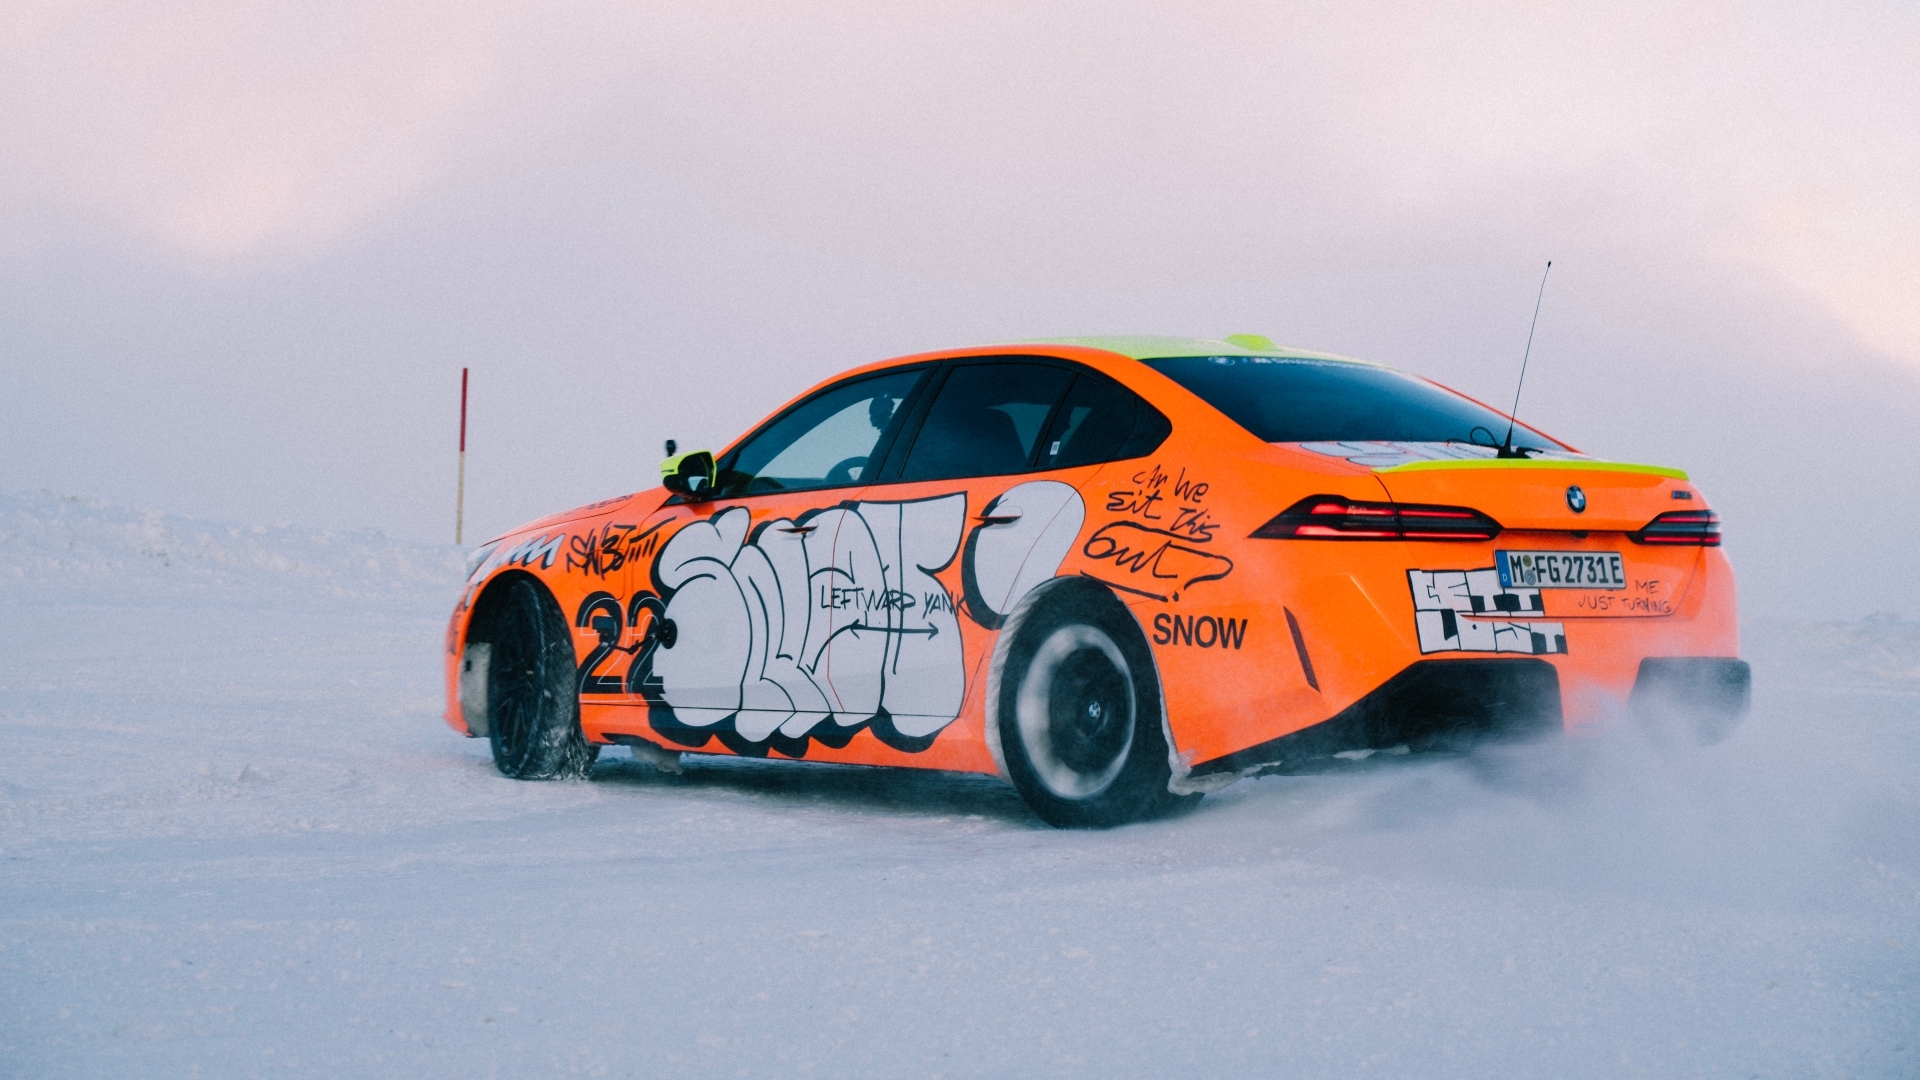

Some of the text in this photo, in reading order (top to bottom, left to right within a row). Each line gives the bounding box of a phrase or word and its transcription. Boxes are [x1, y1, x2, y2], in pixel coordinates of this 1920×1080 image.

[1509, 555, 1525, 583] M
[1578, 594, 1616, 611] JUST
[1152, 612, 1248, 650] SNOW
